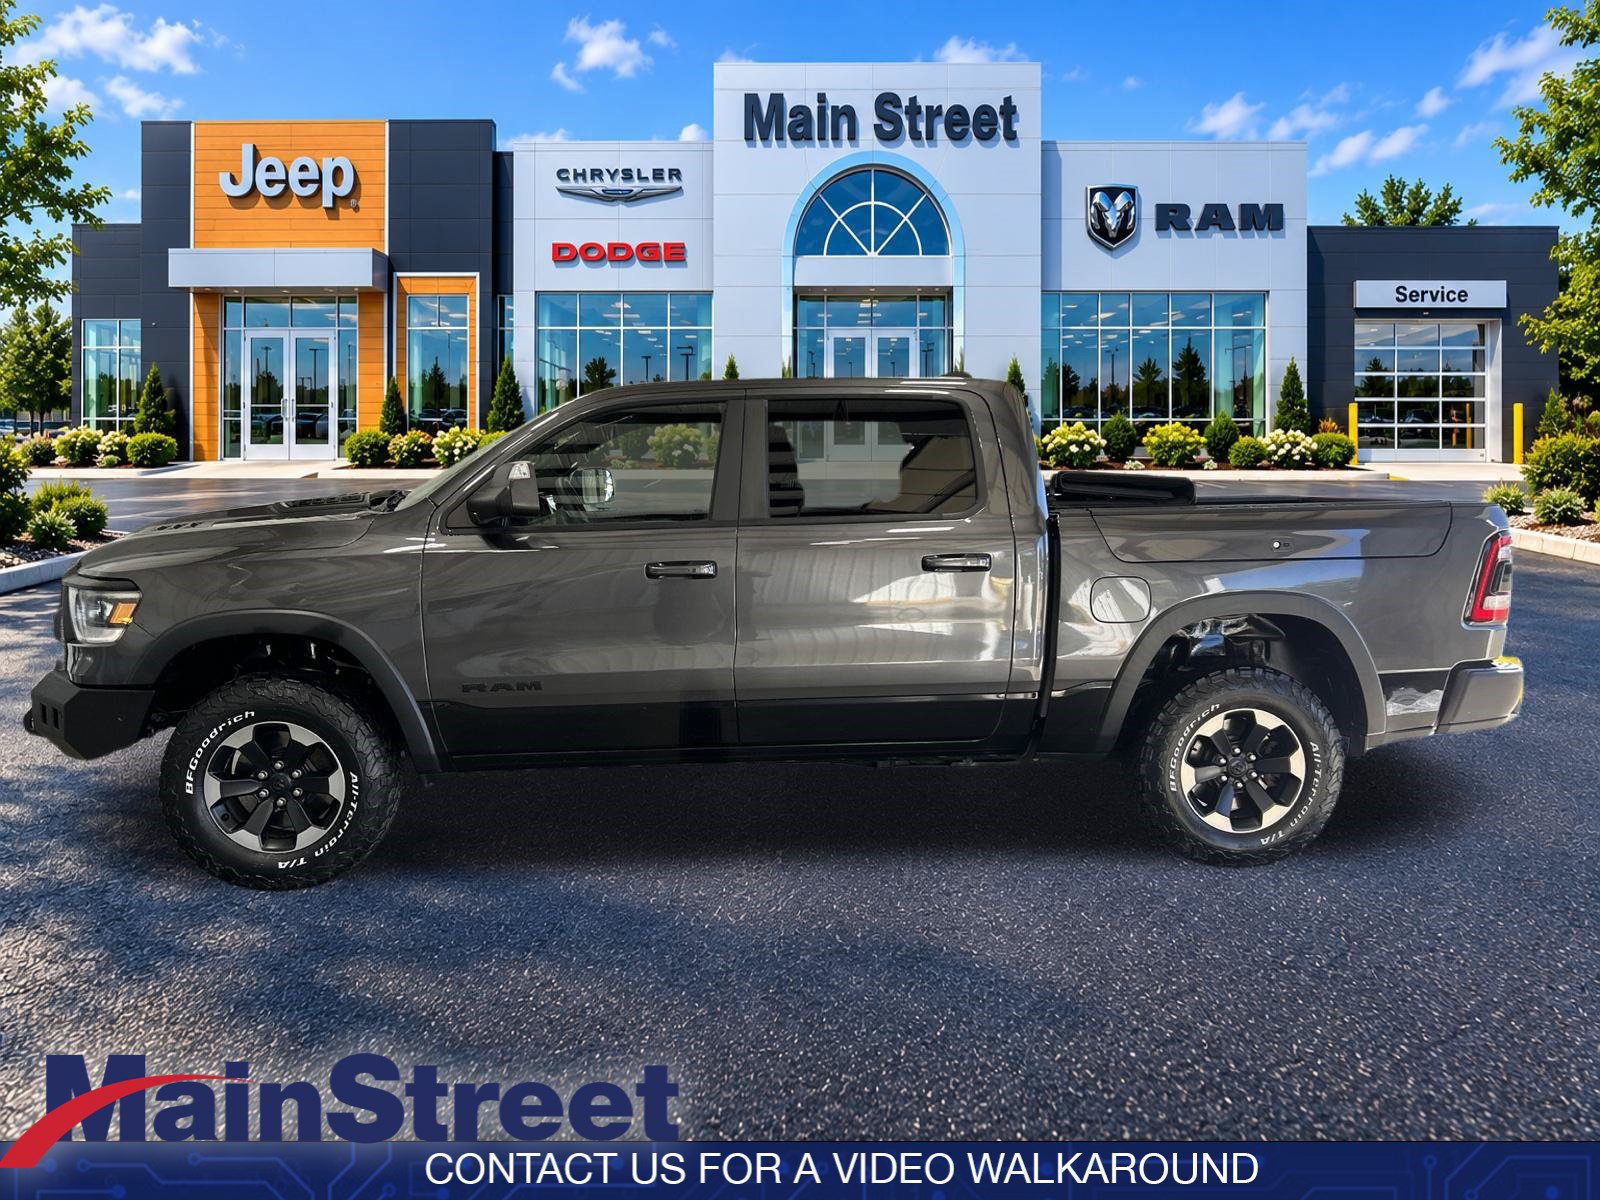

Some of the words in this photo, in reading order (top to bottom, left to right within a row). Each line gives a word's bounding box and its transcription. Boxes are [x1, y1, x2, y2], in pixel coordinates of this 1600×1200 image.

[744, 92, 857, 142] Main
[873, 91, 1019, 142] Street
[219, 143, 355, 208] Jeep
[556, 168, 683, 183] CHRYSLER
[1155, 203, 1284, 231] RAM
[551, 242, 687, 262] DODGE
[1395, 285, 1469, 304] Service
[462, 681, 543, 693] RAM
[185, 711, 255, 795] BFGoodrich
[1169, 702, 1221, 792] BFGoodrich
[1260, 830, 1285, 846] T/A
[278, 860, 307, 870] T/A
